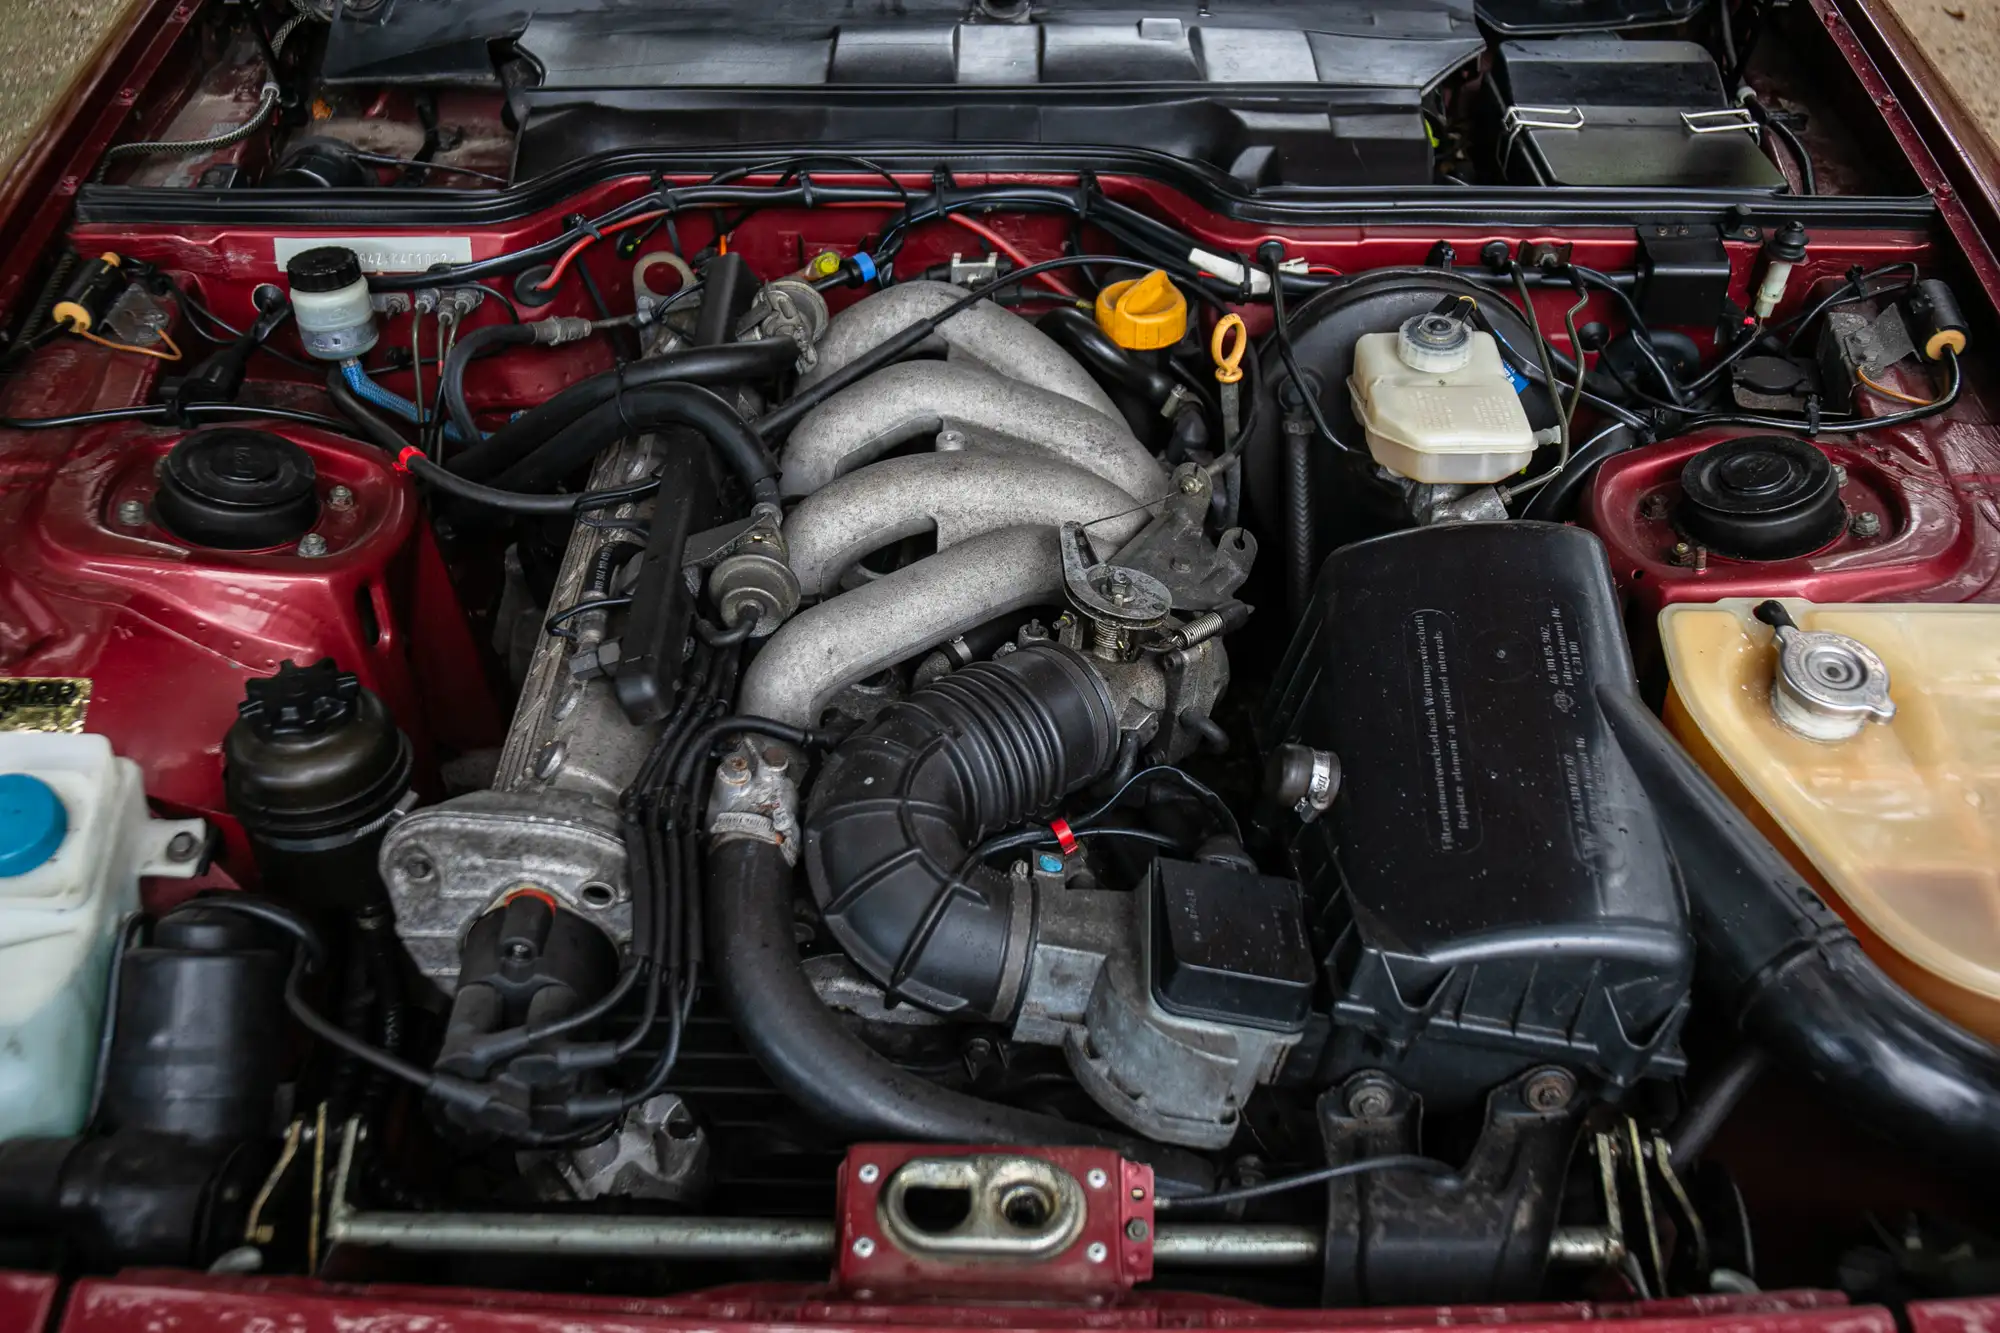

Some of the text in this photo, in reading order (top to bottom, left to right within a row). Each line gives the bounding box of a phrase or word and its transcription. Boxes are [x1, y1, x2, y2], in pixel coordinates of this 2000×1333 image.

[1413, 614, 1434, 707] Wartungsvorschrift
[1433, 630, 1448, 673] intervals
[1425, 708, 1438, 733] nach
[1438, 676, 1456, 721] specified
[1455, 785, 1470, 830] Replace
